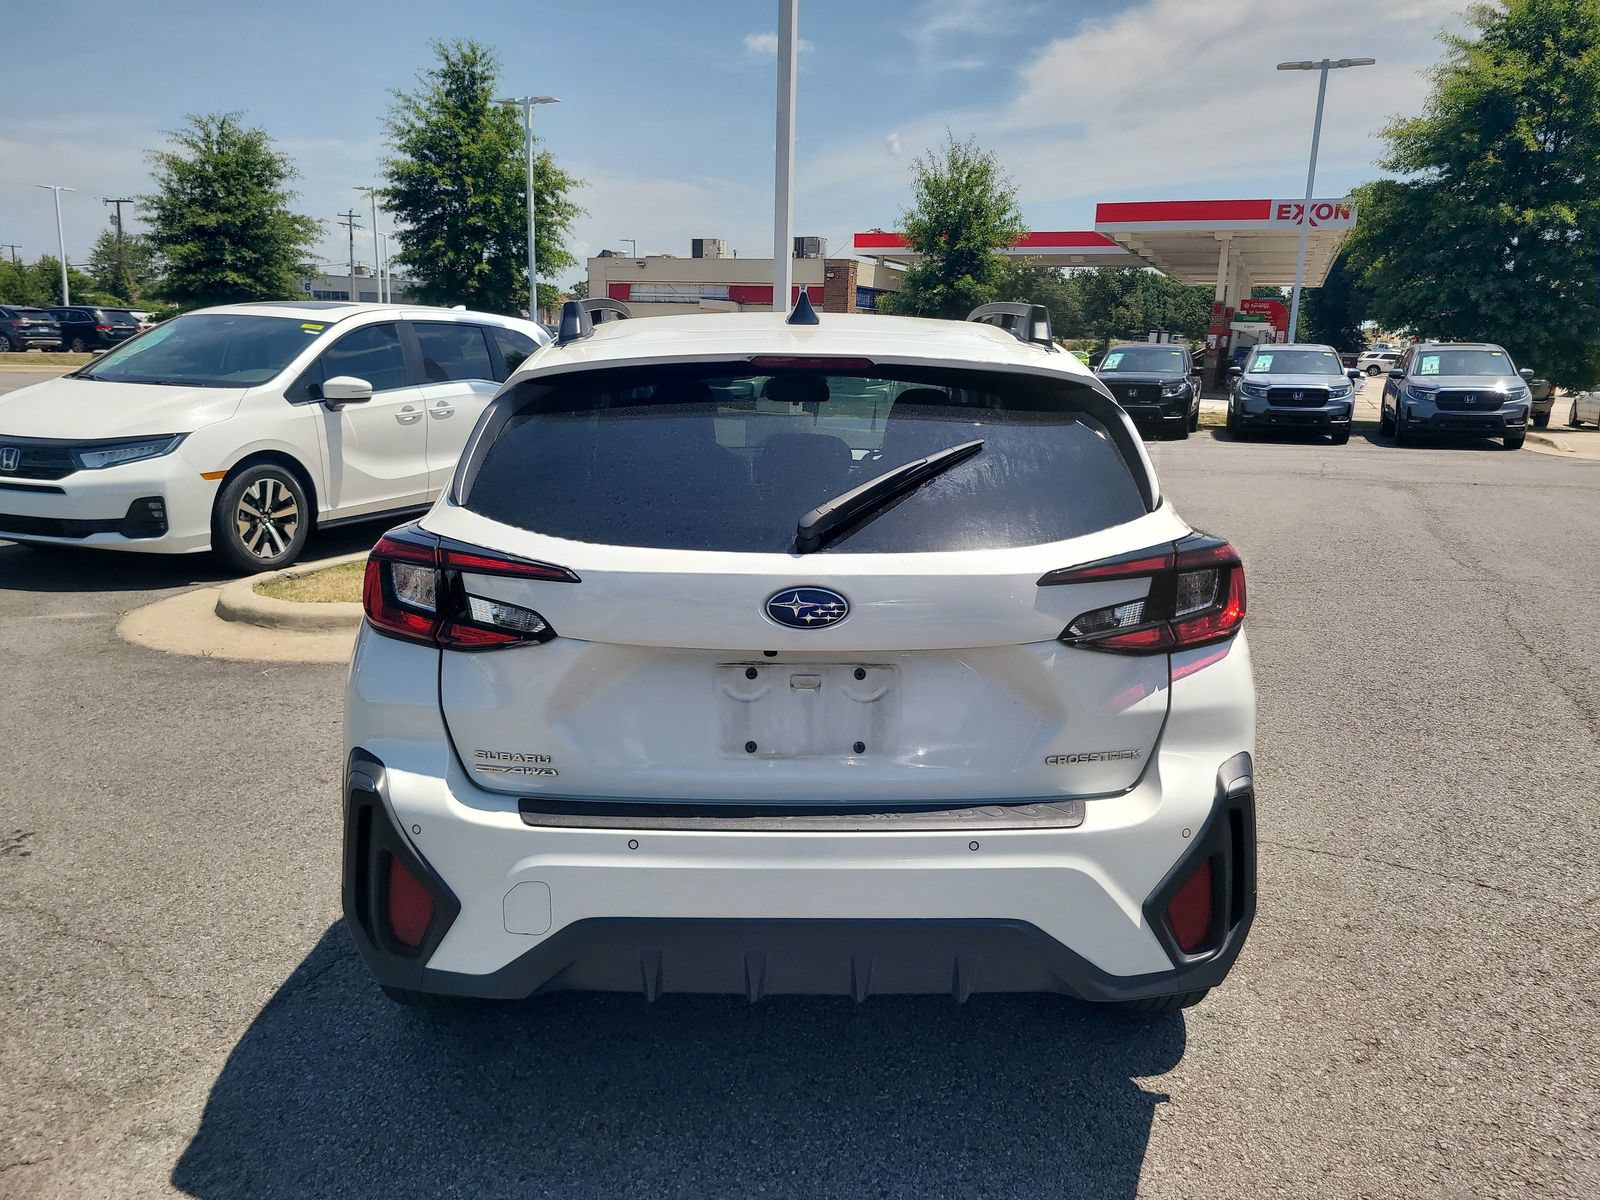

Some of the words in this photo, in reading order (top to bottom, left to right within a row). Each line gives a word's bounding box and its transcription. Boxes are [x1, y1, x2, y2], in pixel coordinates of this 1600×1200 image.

[1277, 203, 1350, 226] EXXON
[474, 749, 551, 764] SUBARU
[1045, 748, 1141, 766] CROSSTREK
